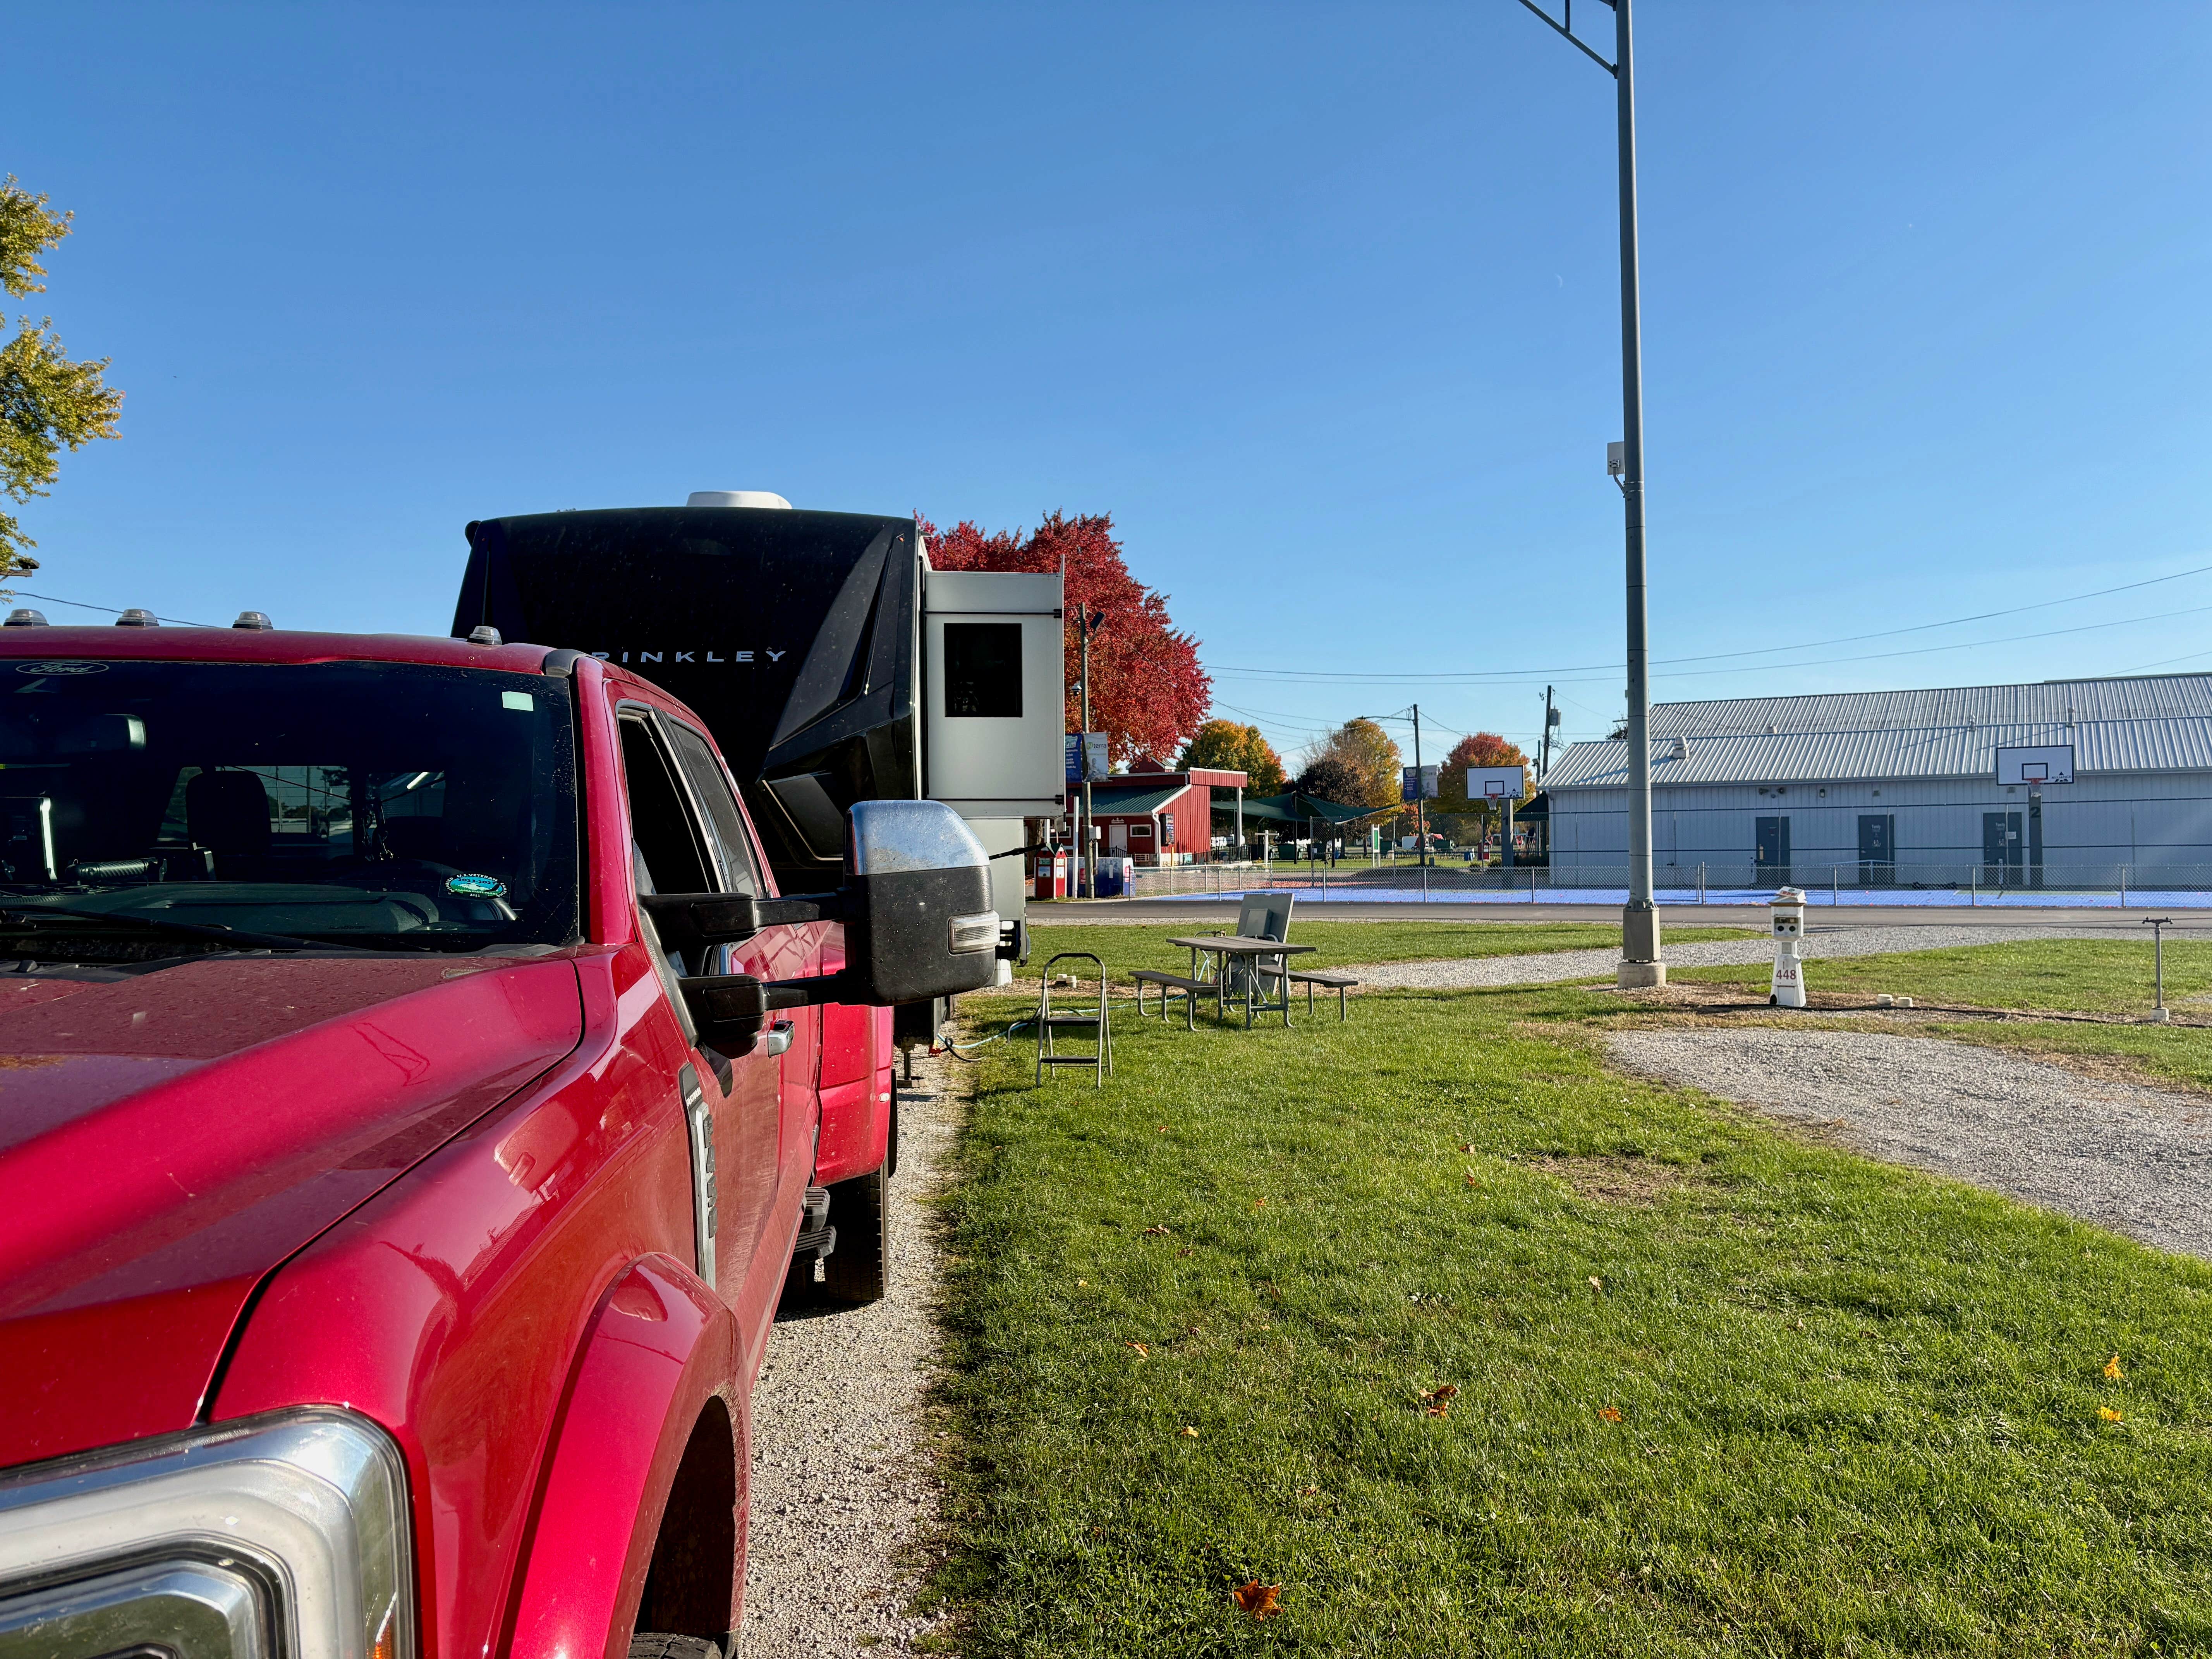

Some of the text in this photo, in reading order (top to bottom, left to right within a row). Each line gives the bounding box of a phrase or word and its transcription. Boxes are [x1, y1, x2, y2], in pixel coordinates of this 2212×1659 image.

[591, 651, 786, 663] RINKLEY
[30, 663, 94, 673] Ford
[2030, 807, 2041, 818] 2
[1503, 816, 1508, 825] 1
[1776, 970, 1796, 979] 448
